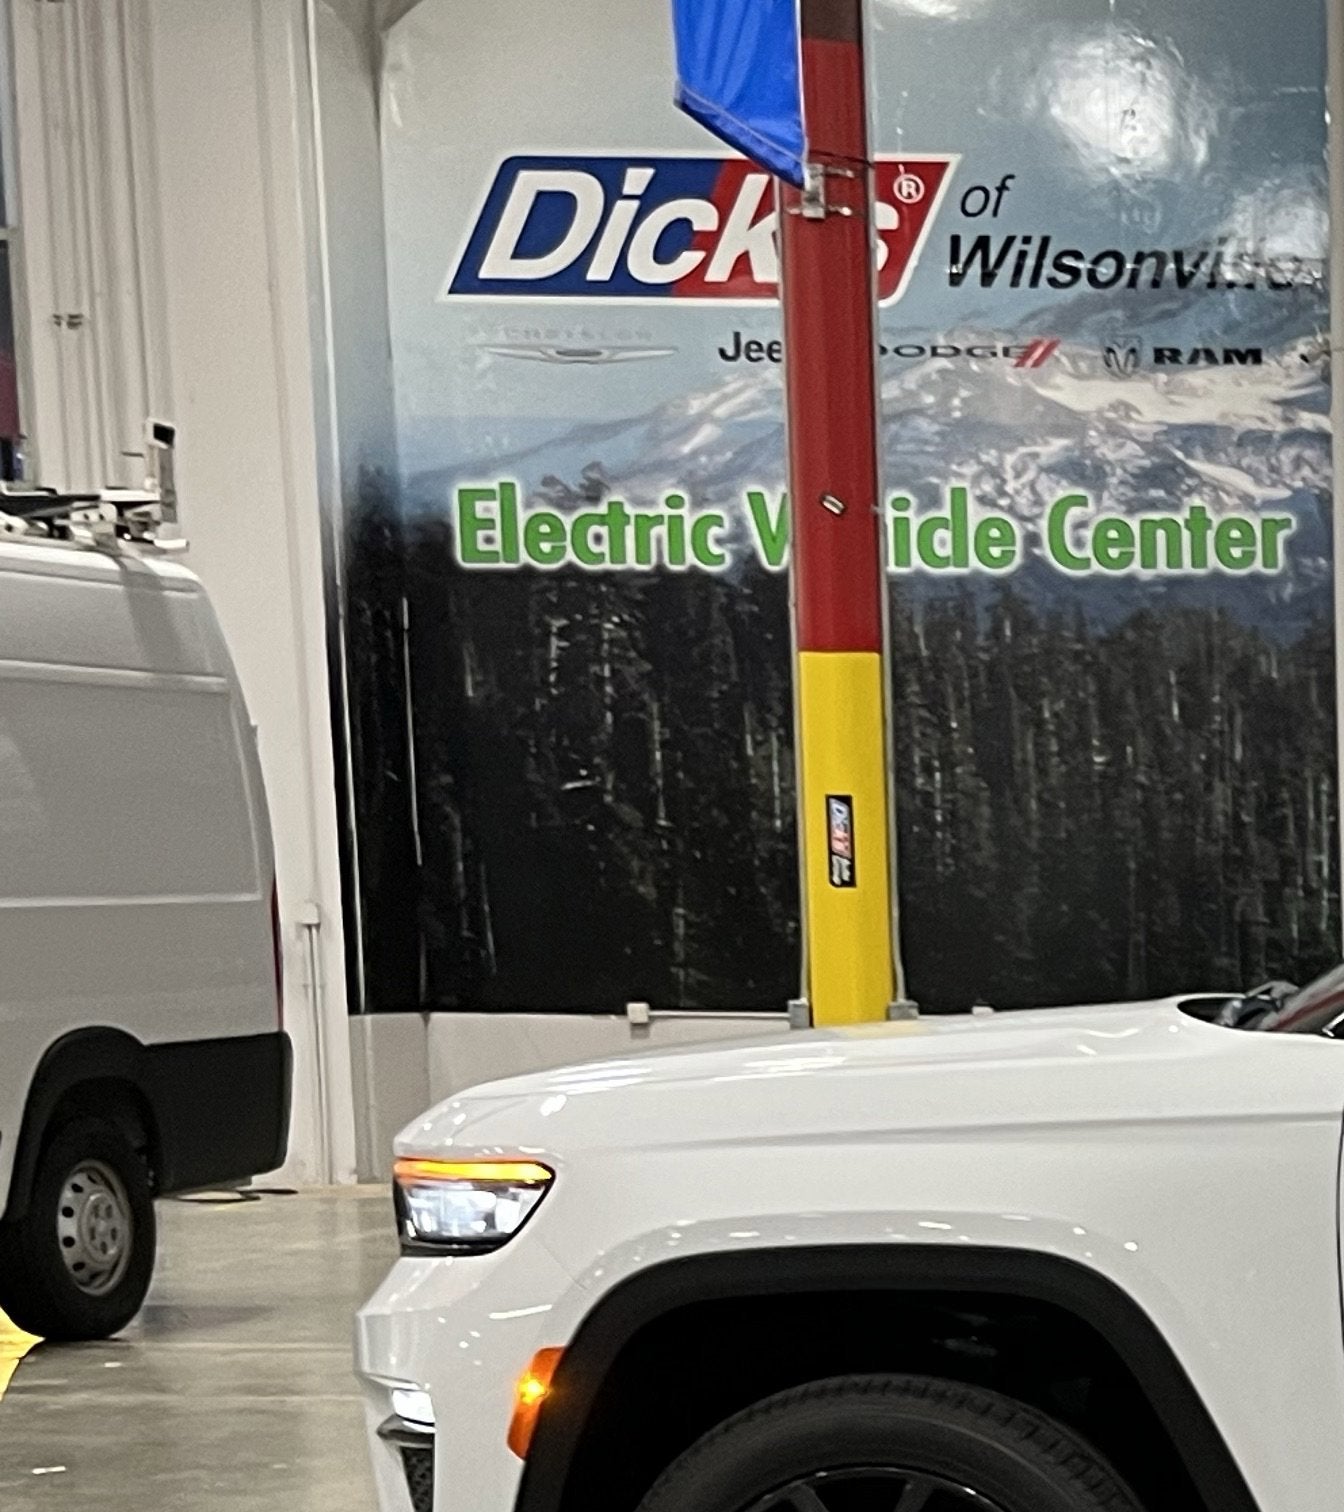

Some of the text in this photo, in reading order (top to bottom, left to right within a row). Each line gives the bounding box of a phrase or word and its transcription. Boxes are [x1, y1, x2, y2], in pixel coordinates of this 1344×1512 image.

[960, 174, 1015, 218] of
[478, 167, 900, 283] Dick
[948, 234, 1306, 290] Wilsonvi
[718, 331, 782, 363] Jee
[878, 344, 1030, 359] ODGE
[1153, 347, 1263, 366] RAM
[457, 481, 1293, 571] Electric Vicle Center
